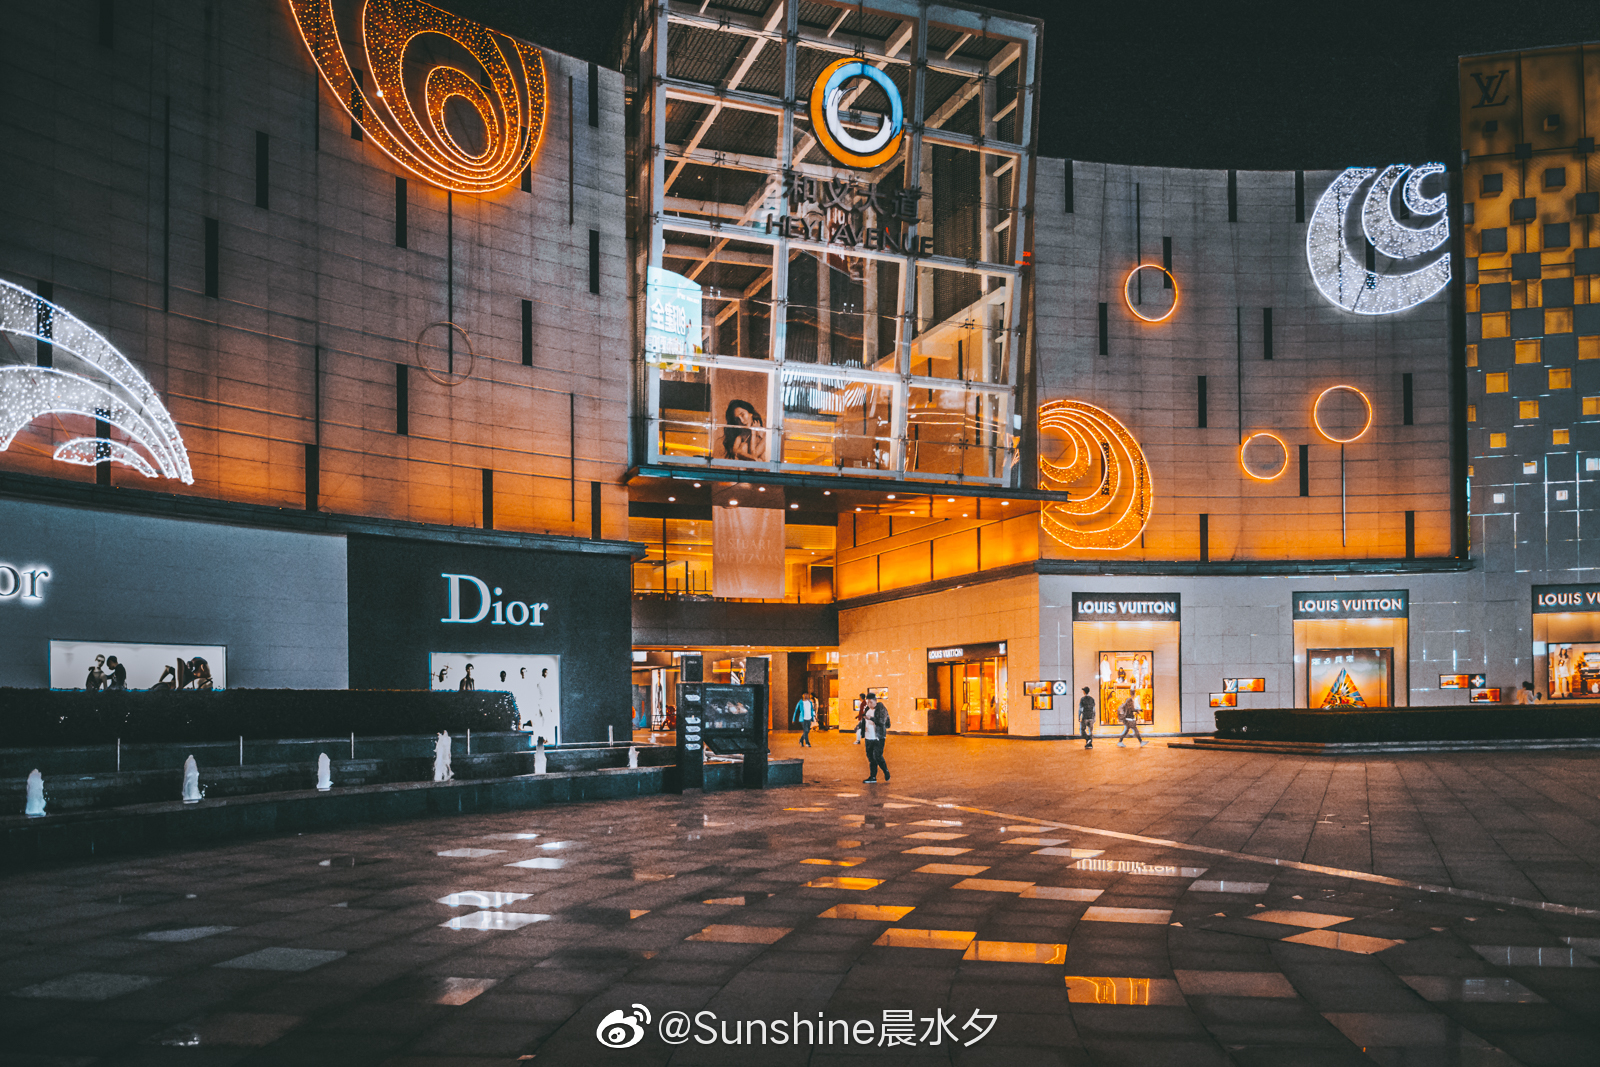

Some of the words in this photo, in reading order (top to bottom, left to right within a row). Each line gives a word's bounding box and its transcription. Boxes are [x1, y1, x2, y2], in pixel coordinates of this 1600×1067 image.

[782, 172, 921, 224] 和义大道
[766, 213, 823, 242] HEYI
[830, 224, 934, 256] AVENUE
[441, 573, 549, 626] Dior
[1299, 600, 1340, 612] LOUIS
[1342, 598, 1403, 612] VUITTON
[1538, 592, 1583, 606] LOUIS
[1585, 591, 1600, 605] V
[1078, 601, 1117, 614] LOUIS
[1119, 601, 1176, 614] VUITTON
[929, 650, 943, 659] LOUIS
[943, 648, 964, 658] VUITTON
